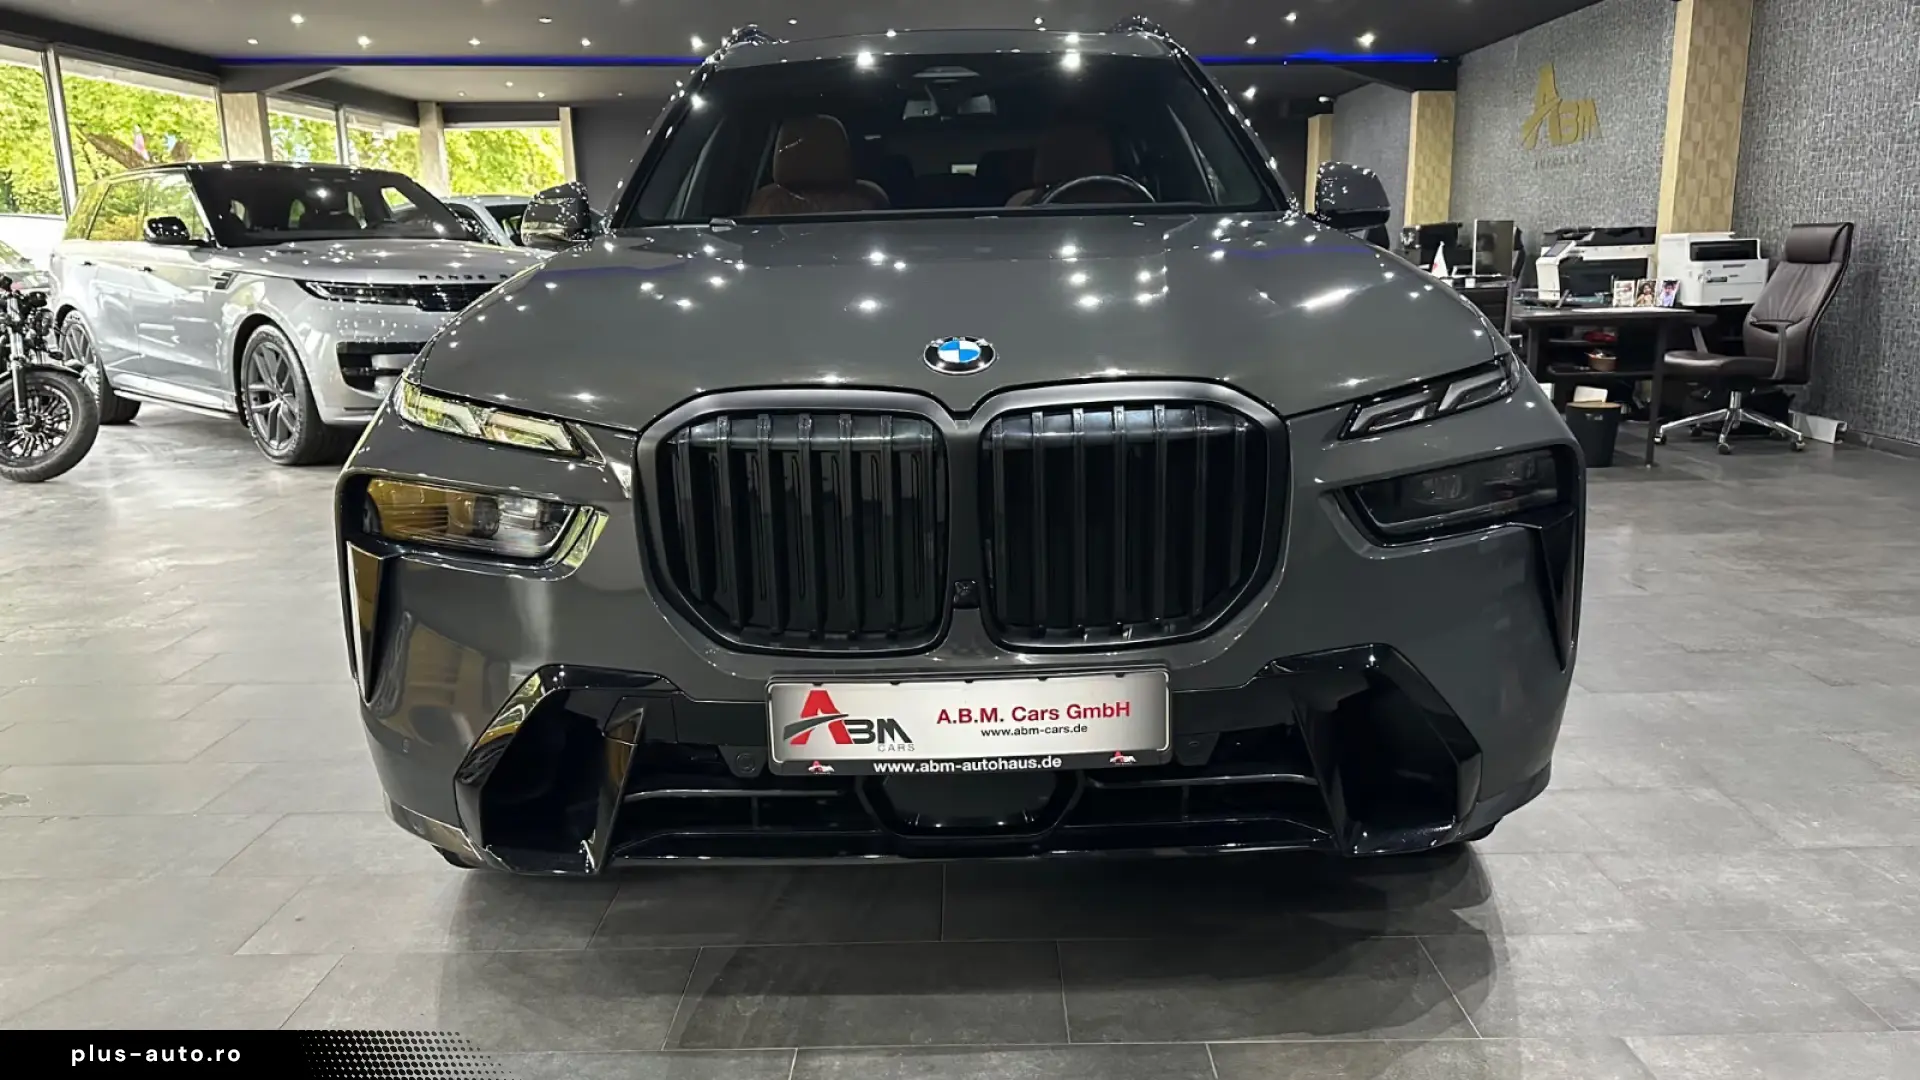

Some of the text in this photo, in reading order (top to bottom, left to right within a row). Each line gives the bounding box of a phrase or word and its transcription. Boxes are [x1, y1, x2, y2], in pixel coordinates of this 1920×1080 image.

[1521, 61, 1602, 151] ABM
[783, 690, 913, 745] ABM
[936, 701, 1131, 725] A.B.M. Cars GmbH
[980, 723, 1088, 738] www.abm-cars.de
[877, 743, 916, 752] CARS
[873, 755, 1062, 774] www.abm-autohaus.de
